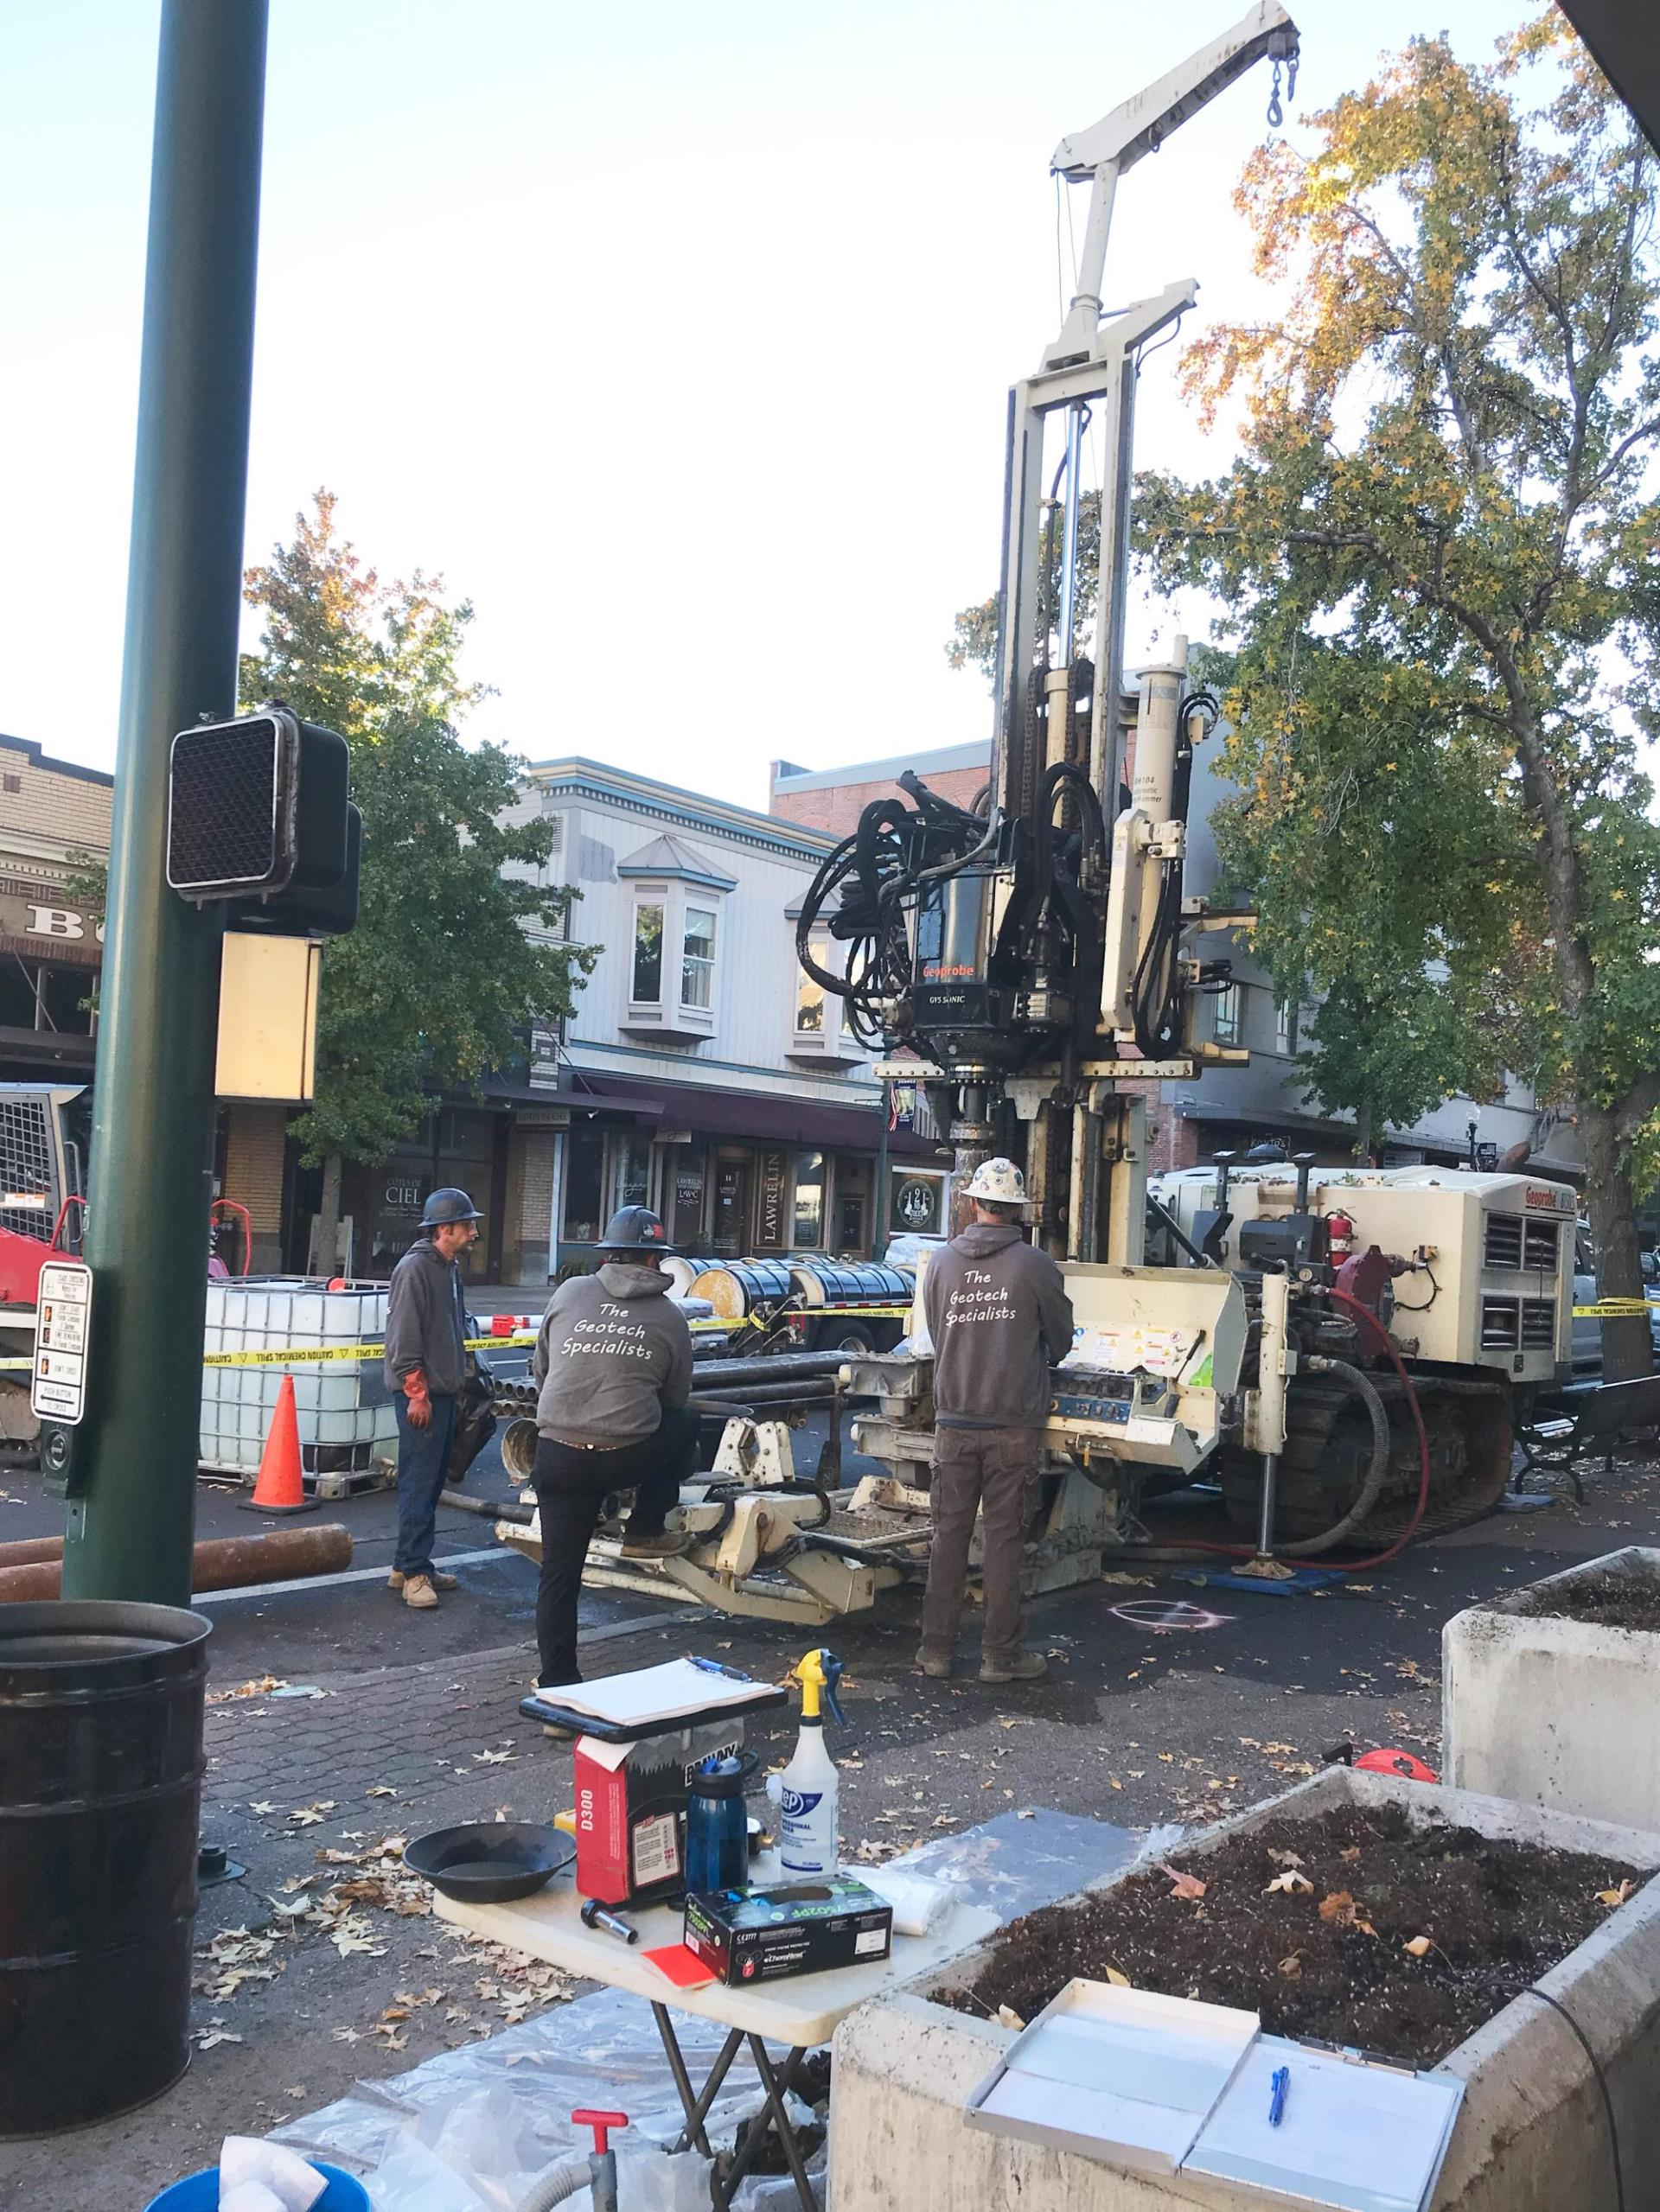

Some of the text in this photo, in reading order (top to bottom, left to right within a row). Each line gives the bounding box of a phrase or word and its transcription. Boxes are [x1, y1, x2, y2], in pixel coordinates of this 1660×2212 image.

[923, 964, 974, 978] Geoprobe
[386, 1187, 421, 1204] CIEL
[765, 1153, 779, 1241] LAWRELIN
[964, 1270, 992, 1284] The
[950, 1286, 1009, 1305] Geotech
[599, 1303, 629, 1318] The
[945, 1306, 1017, 1329] Specialists
[573, 1319, 646, 1339] Geotech
[256, 1350, 334, 1362] CAUTION CHEMICAL SPILL
[560, 1337, 653, 1361] Specialists
[782, 1791, 798, 1810] ep
[580, 1789, 594, 1832] D300
